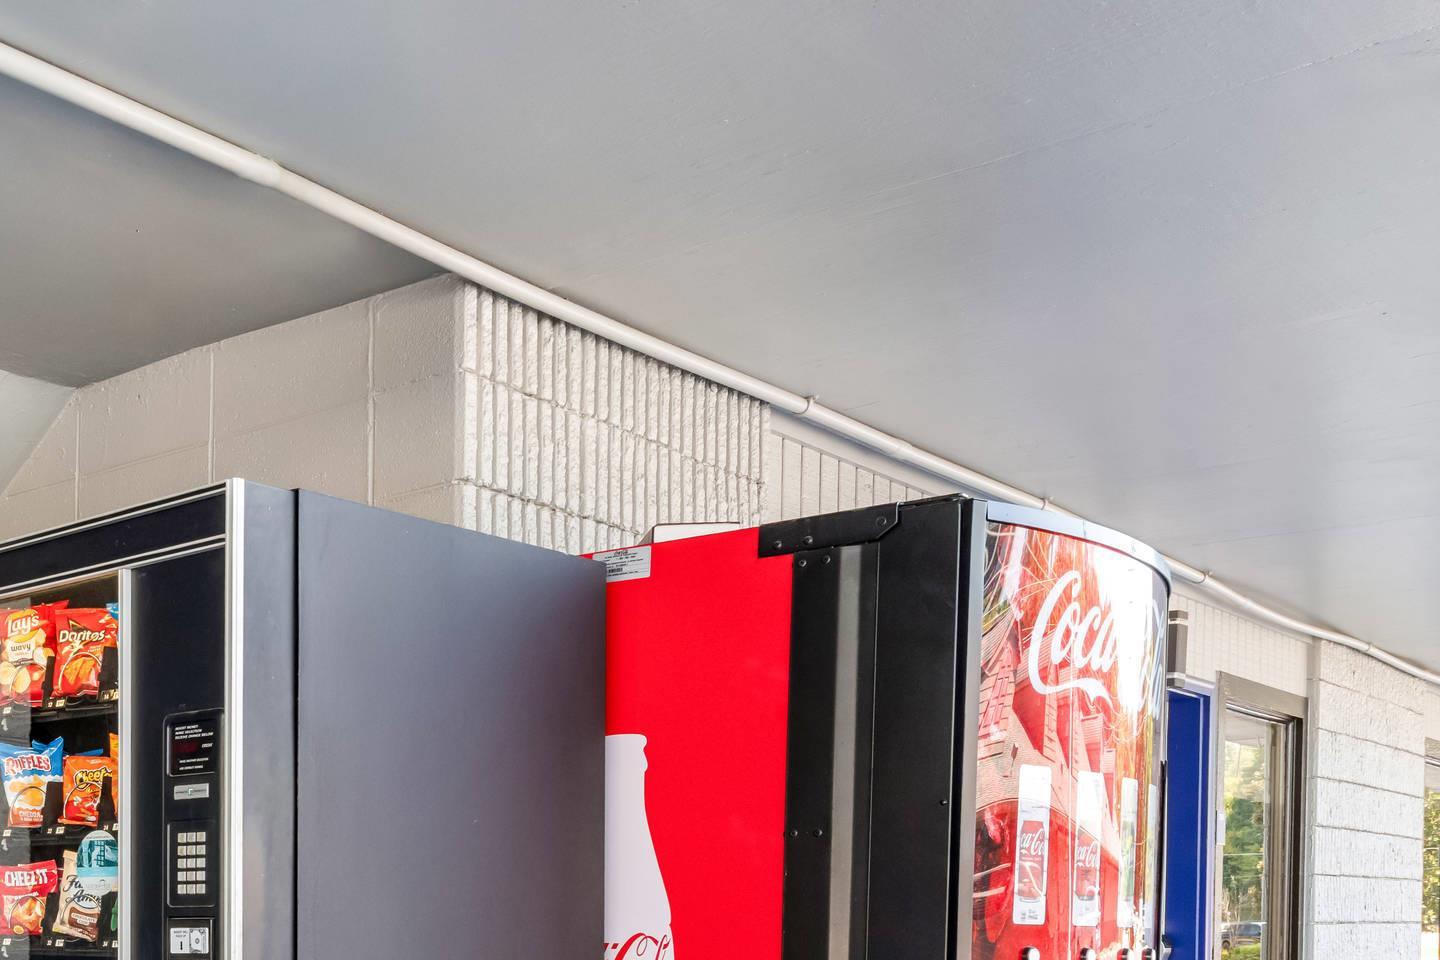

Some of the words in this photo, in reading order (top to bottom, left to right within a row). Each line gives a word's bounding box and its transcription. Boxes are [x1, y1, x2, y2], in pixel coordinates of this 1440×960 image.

[7, 614, 40, 637] Lay's
[59, 629, 106, 643] Doritos
[10, 642, 31, 652] wavy
[5, 755, 51, 775] RUFFLES
[74, 768, 112, 788] Cheet
